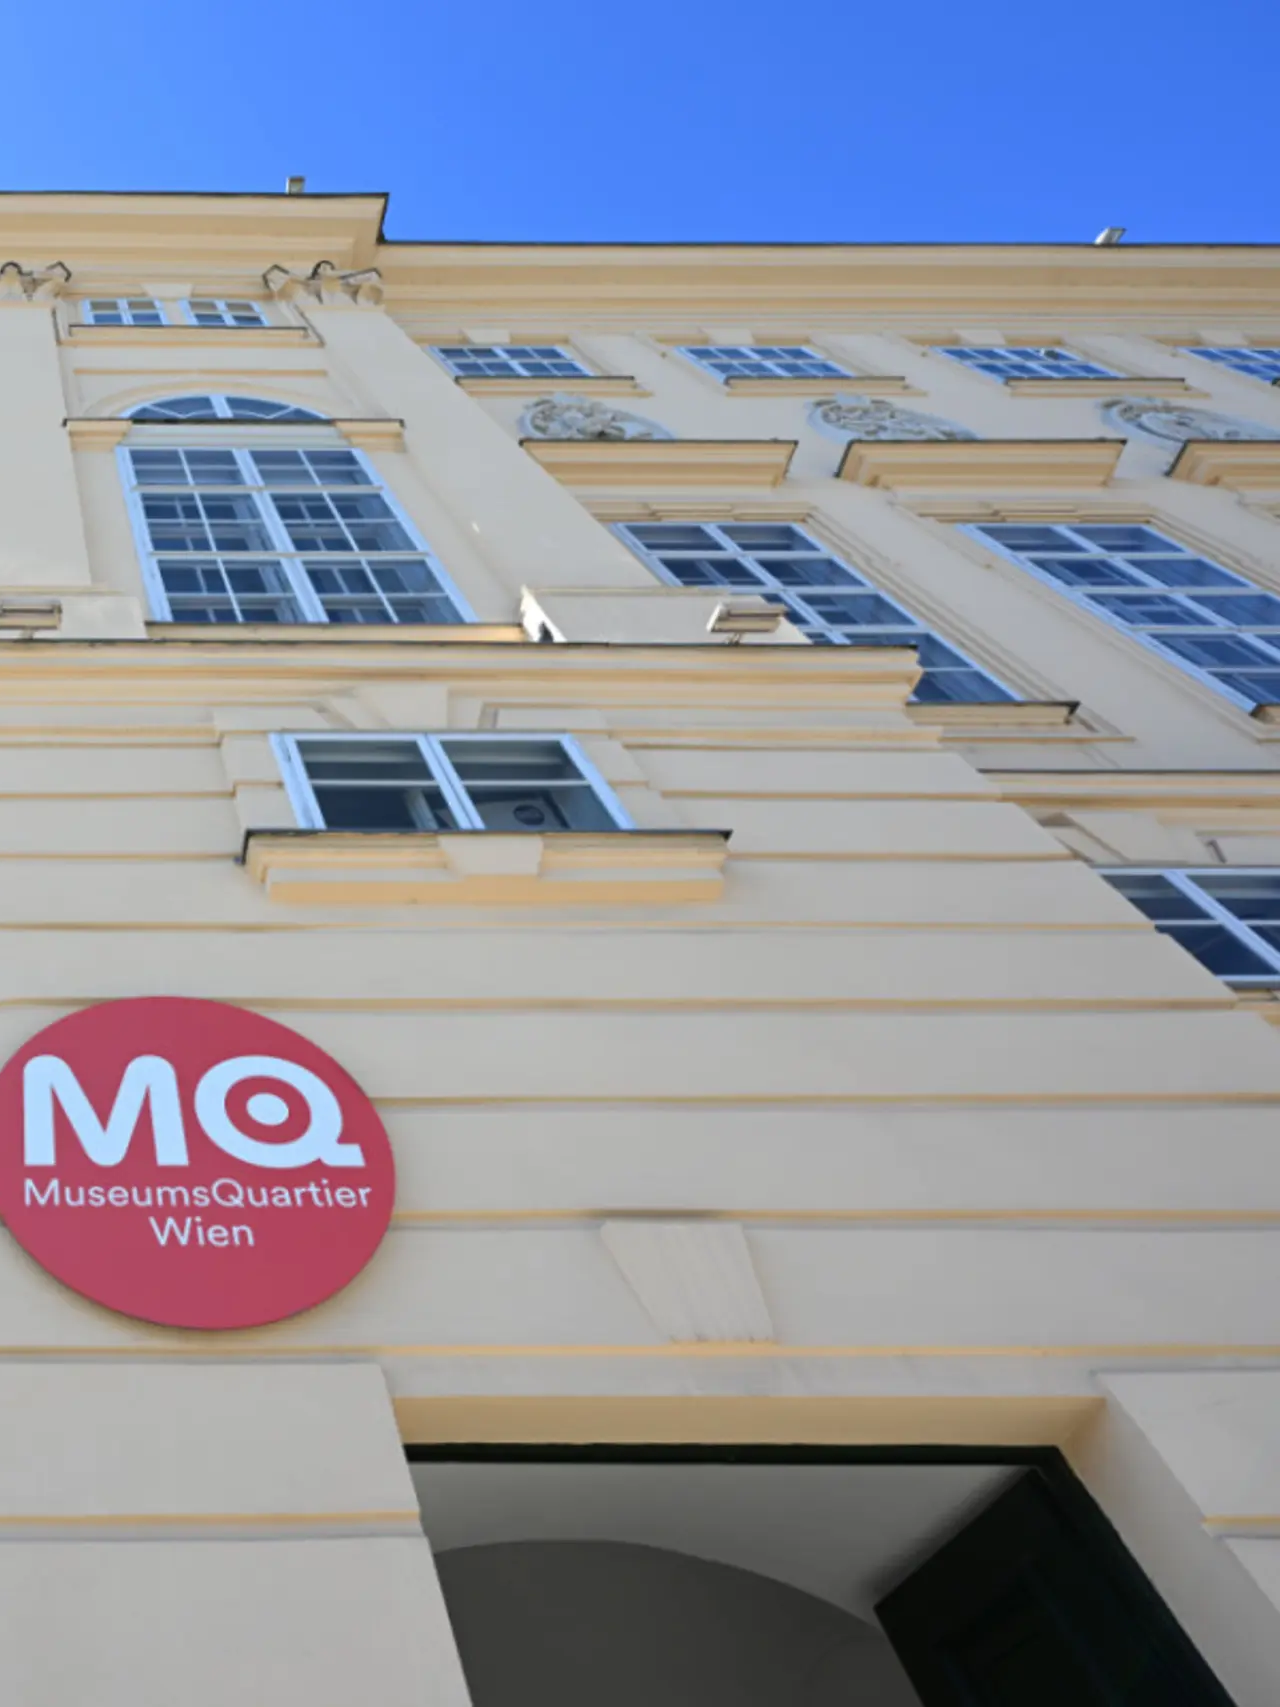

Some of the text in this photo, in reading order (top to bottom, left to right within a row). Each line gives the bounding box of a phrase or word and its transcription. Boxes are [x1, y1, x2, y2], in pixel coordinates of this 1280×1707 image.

[23, 1054, 366, 1169] MQ
[23, 1178, 372, 1208] MuseumsQuartier
[148, 1216, 256, 1248] Wien
